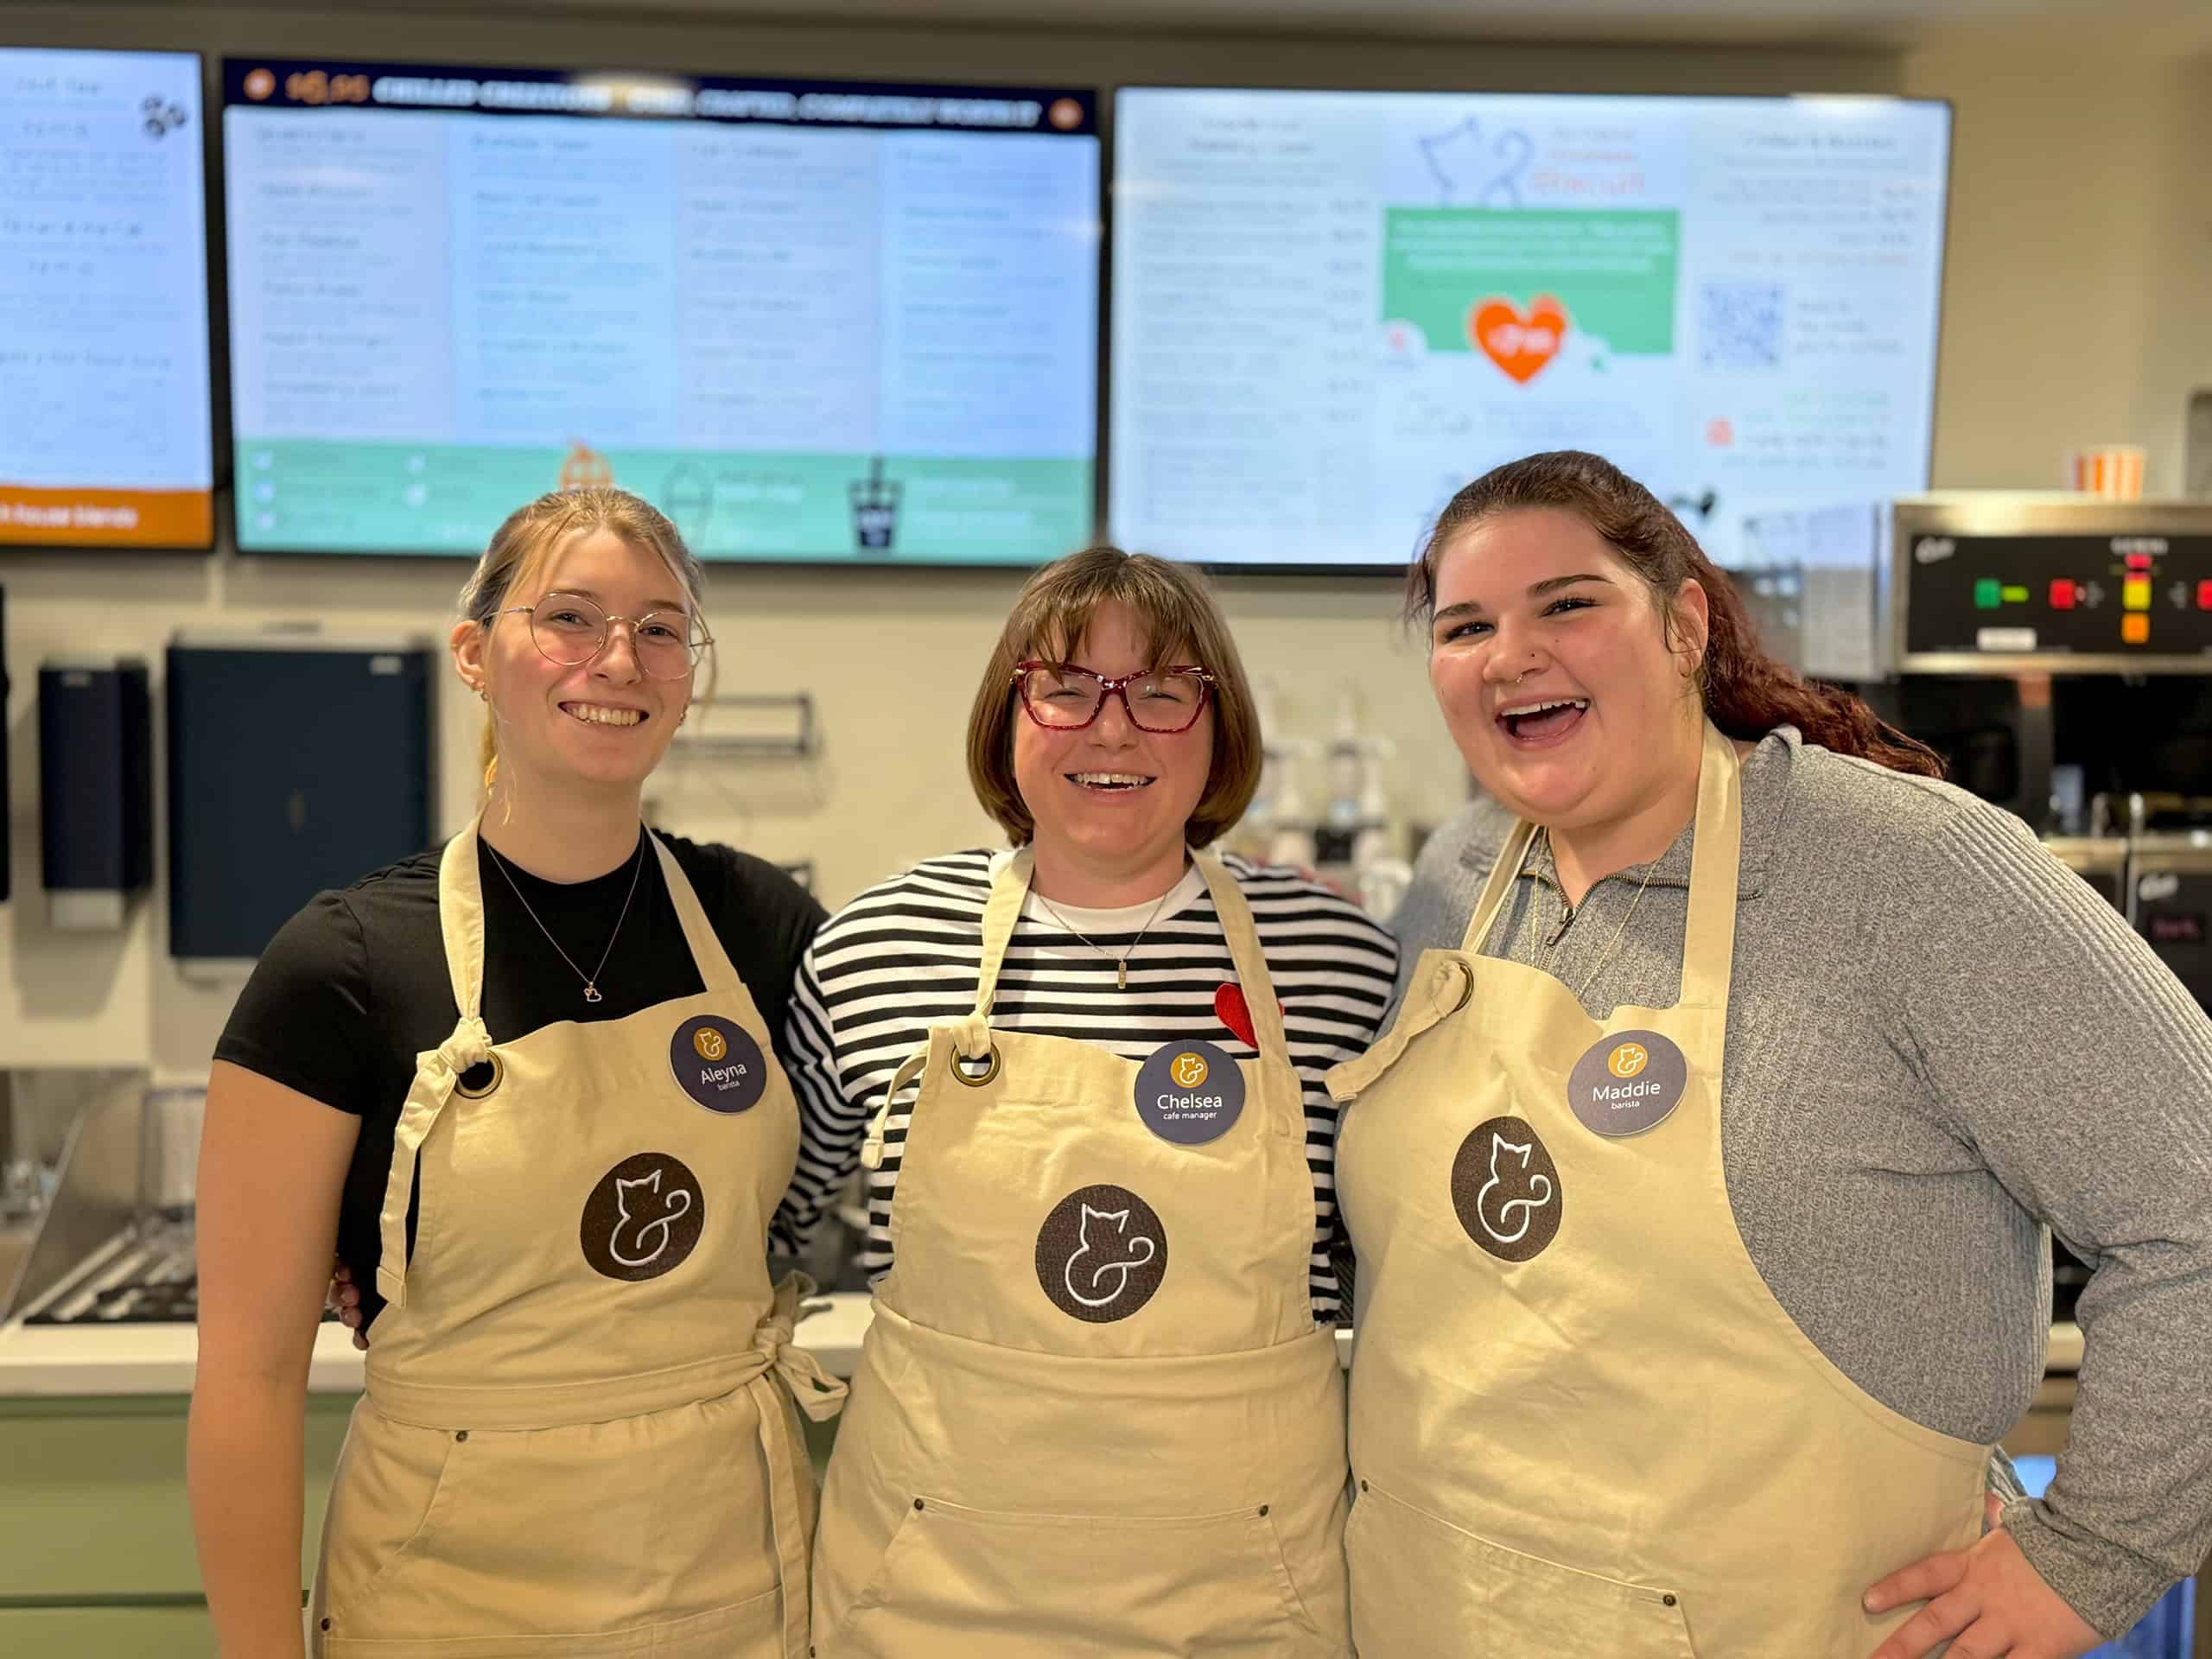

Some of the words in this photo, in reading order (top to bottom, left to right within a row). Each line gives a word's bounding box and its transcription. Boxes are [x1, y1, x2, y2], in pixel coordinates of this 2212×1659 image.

[701, 1064, 747, 1085] Aleyna
[717, 1080, 741, 1091] barista
[1592, 1080, 1661, 1102] Maddie
[1157, 1093, 1223, 1110] Chelsea
[1611, 1100, 1640, 1110] barista
[1163, 1112, 1180, 1121] cafe
[1181, 1112, 1217, 1122] manager
